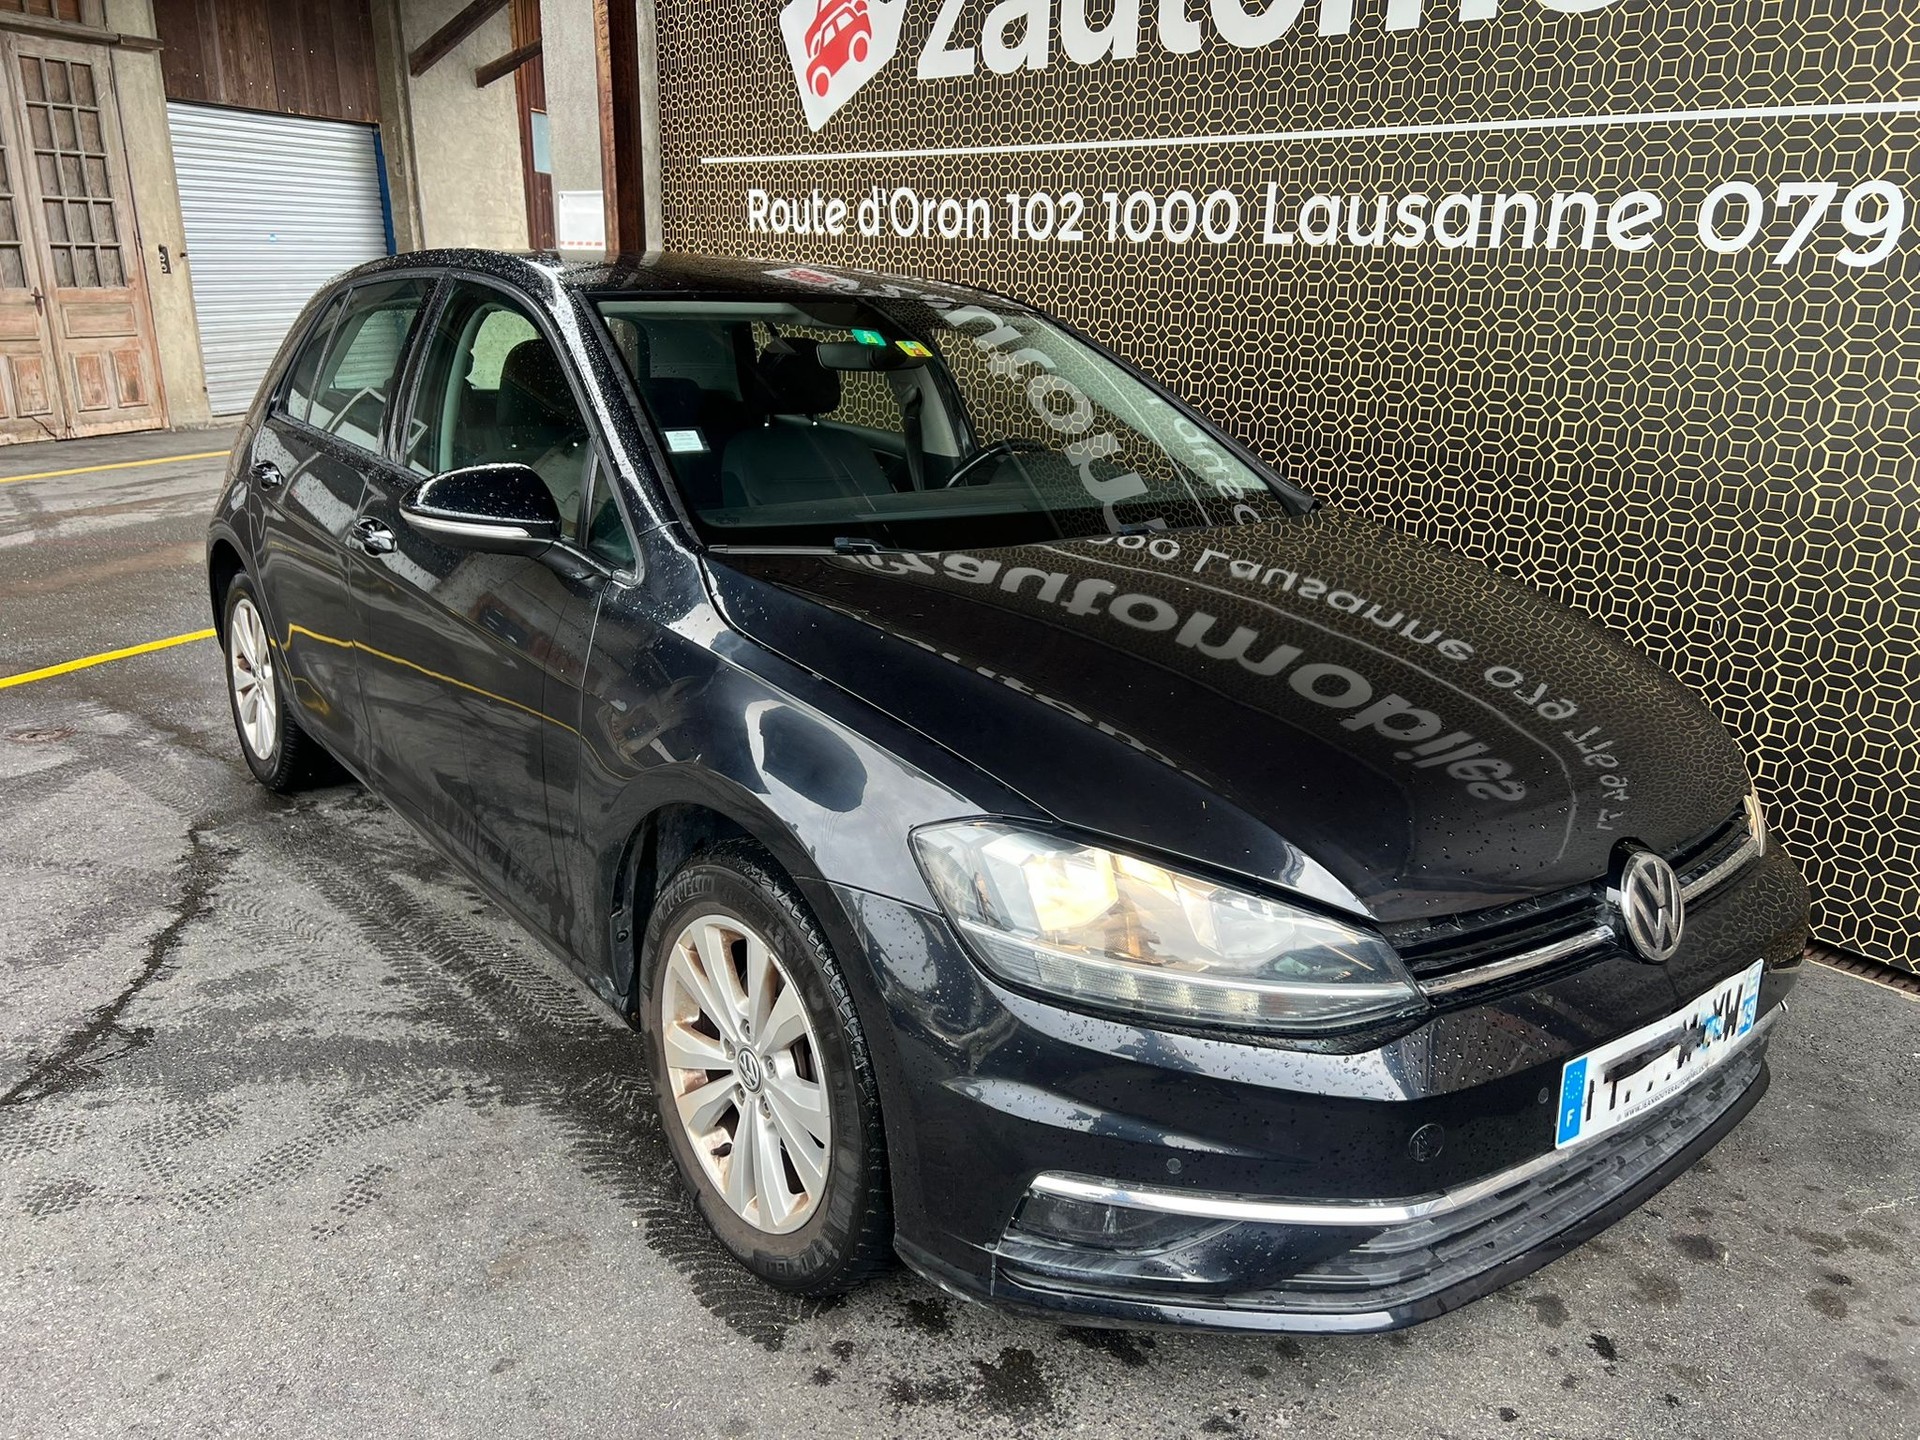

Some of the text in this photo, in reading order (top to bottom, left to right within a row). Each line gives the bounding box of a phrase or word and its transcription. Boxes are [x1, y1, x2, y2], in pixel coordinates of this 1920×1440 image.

[748, 180, 1905, 269] Route d'Oron 102 1000 Lausanne 079
[1566, 1108, 1576, 1128] F
